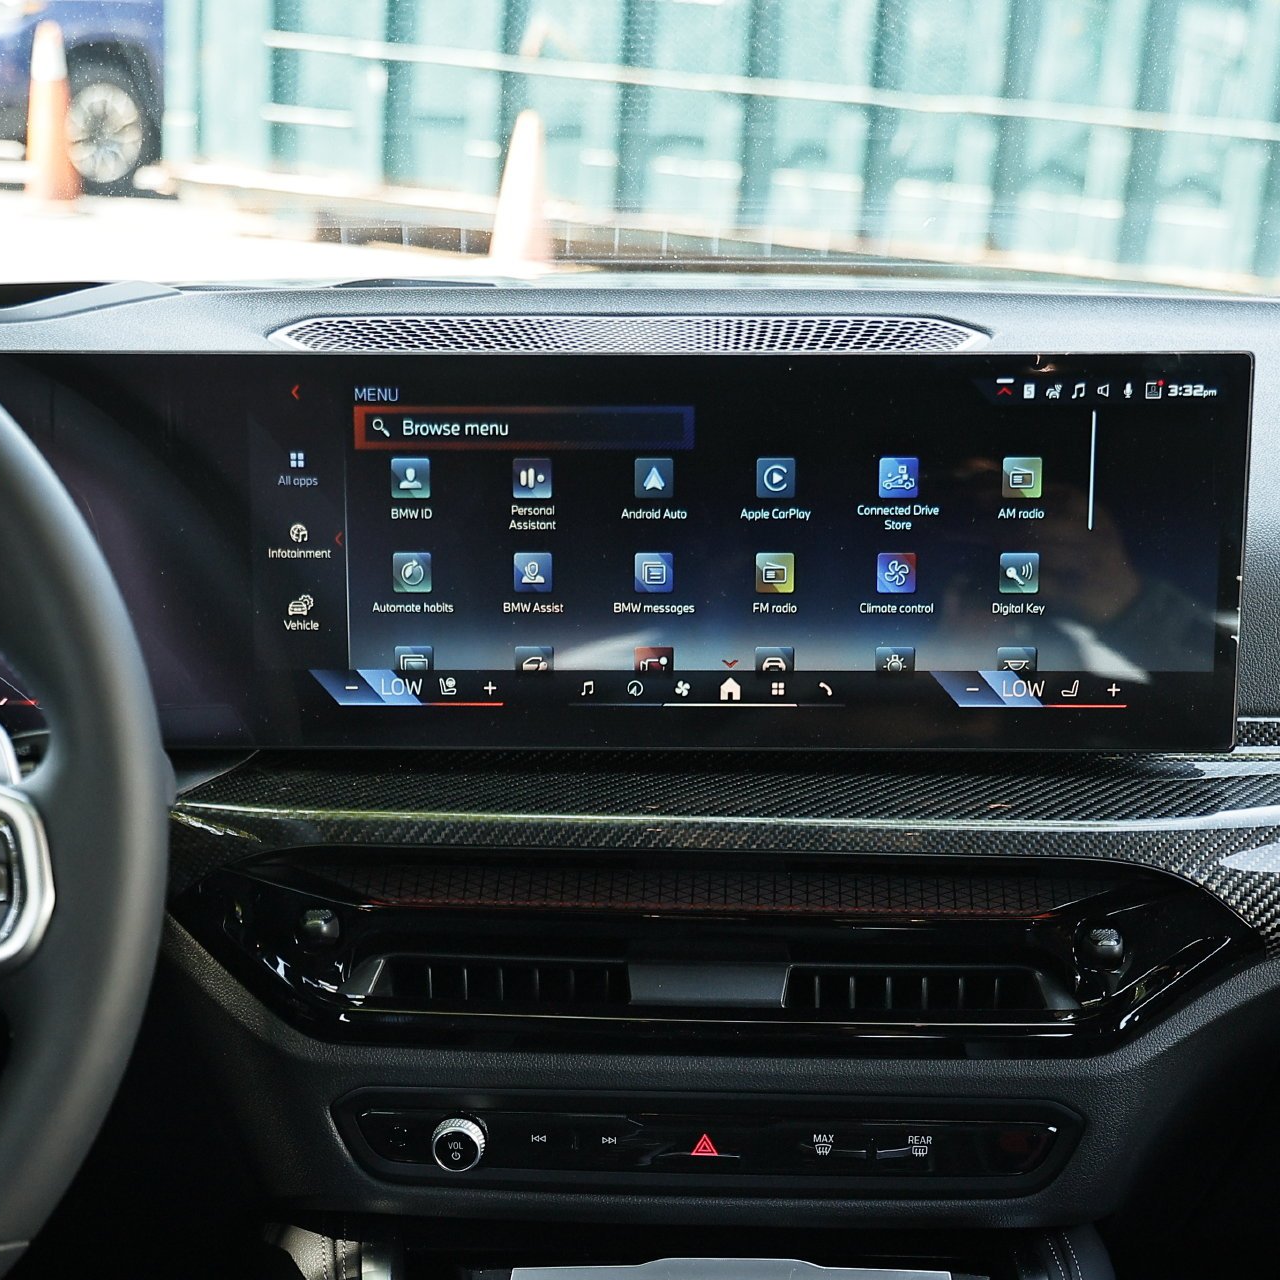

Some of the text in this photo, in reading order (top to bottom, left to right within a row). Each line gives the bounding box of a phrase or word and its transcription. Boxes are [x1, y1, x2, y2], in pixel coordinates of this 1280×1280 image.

[354, 388, 399, 401] MENU
[1168, 385, 1216, 399] 3:32pm
[402, 420, 509, 436] Browse menu
[278, 475, 318, 488] All apps
[391, 509, 432, 520] BMW ID
[511, 505, 555, 516] Personal
[621, 509, 687, 519] Android Auto
[740, 509, 811, 521] Apple CarPlay
[857, 505, 939, 516] Connected Drive
[998, 509, 1044, 519] AM radio
[509, 519, 556, 531] Assistant
[884, 520, 911, 531] Store
[268, 548, 331, 559] Infotainment
[372, 603, 453, 613] Automate habits
[503, 603, 563, 613] BMW Assist
[613, 603, 695, 616] BMW messages
[752, 603, 797, 614] FM radio
[859, 603, 934, 614] Climate control
[992, 603, 1045, 616] Digital Key
[284, 620, 319, 631] Vehicle
[381, 679, 423, 696] LOW
[1002, 681, 1045, 698] LOW
[813, 1134, 834, 1143] MAX
[908, 1136, 932, 1144] REAR
[448, 1142, 463, 1150] VOL
